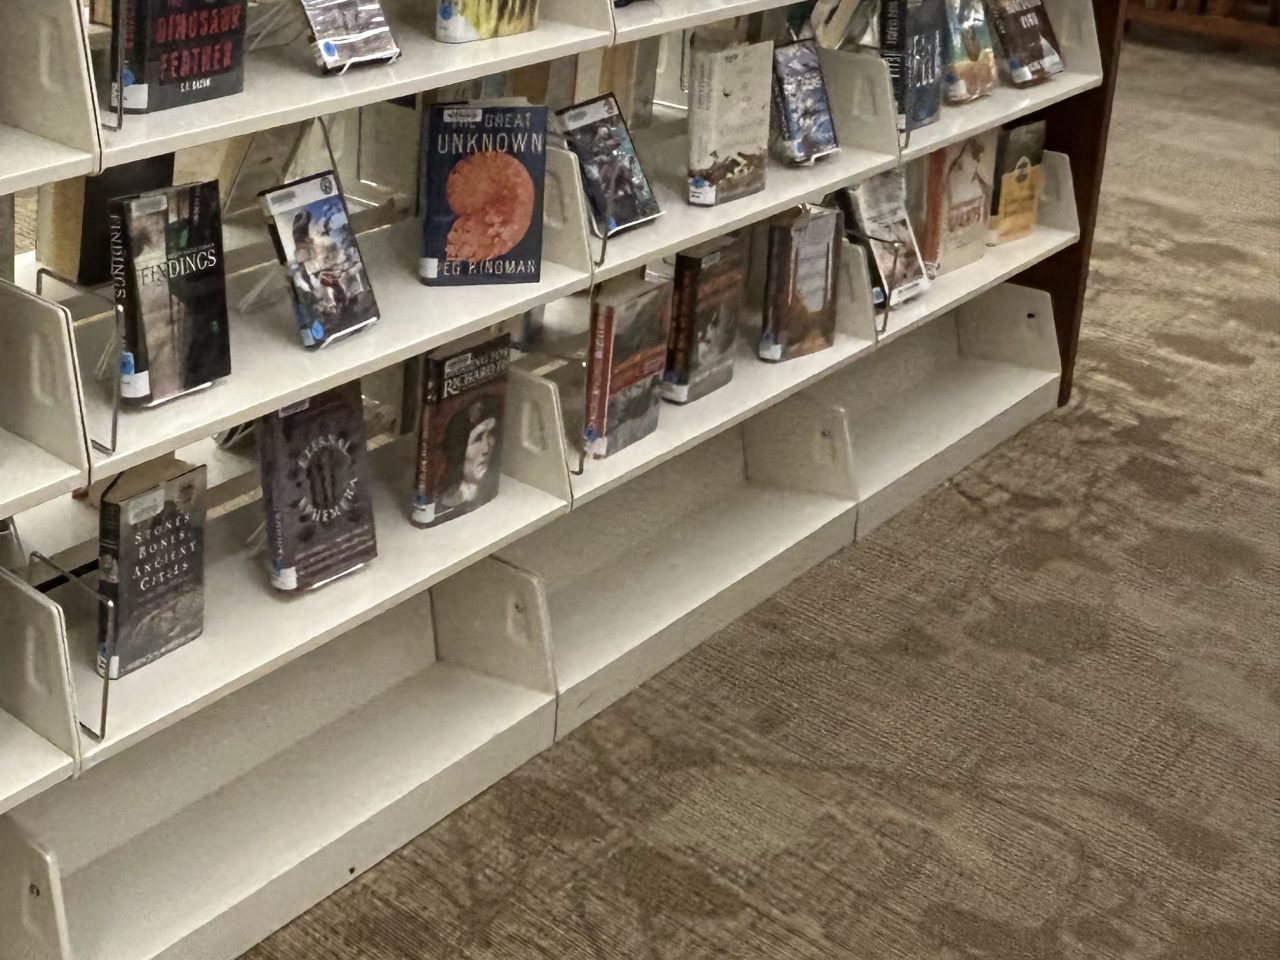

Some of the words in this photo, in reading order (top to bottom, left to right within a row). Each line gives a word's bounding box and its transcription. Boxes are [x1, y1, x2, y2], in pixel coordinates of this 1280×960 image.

[155, 3, 241, 44] DINOSAUR
[159, 40, 233, 82] FEATHER
[484, 111, 532, 129] GREAT
[437, 132, 544, 154] UNKNOWN
[140, 248, 217, 287] FINDINGS
